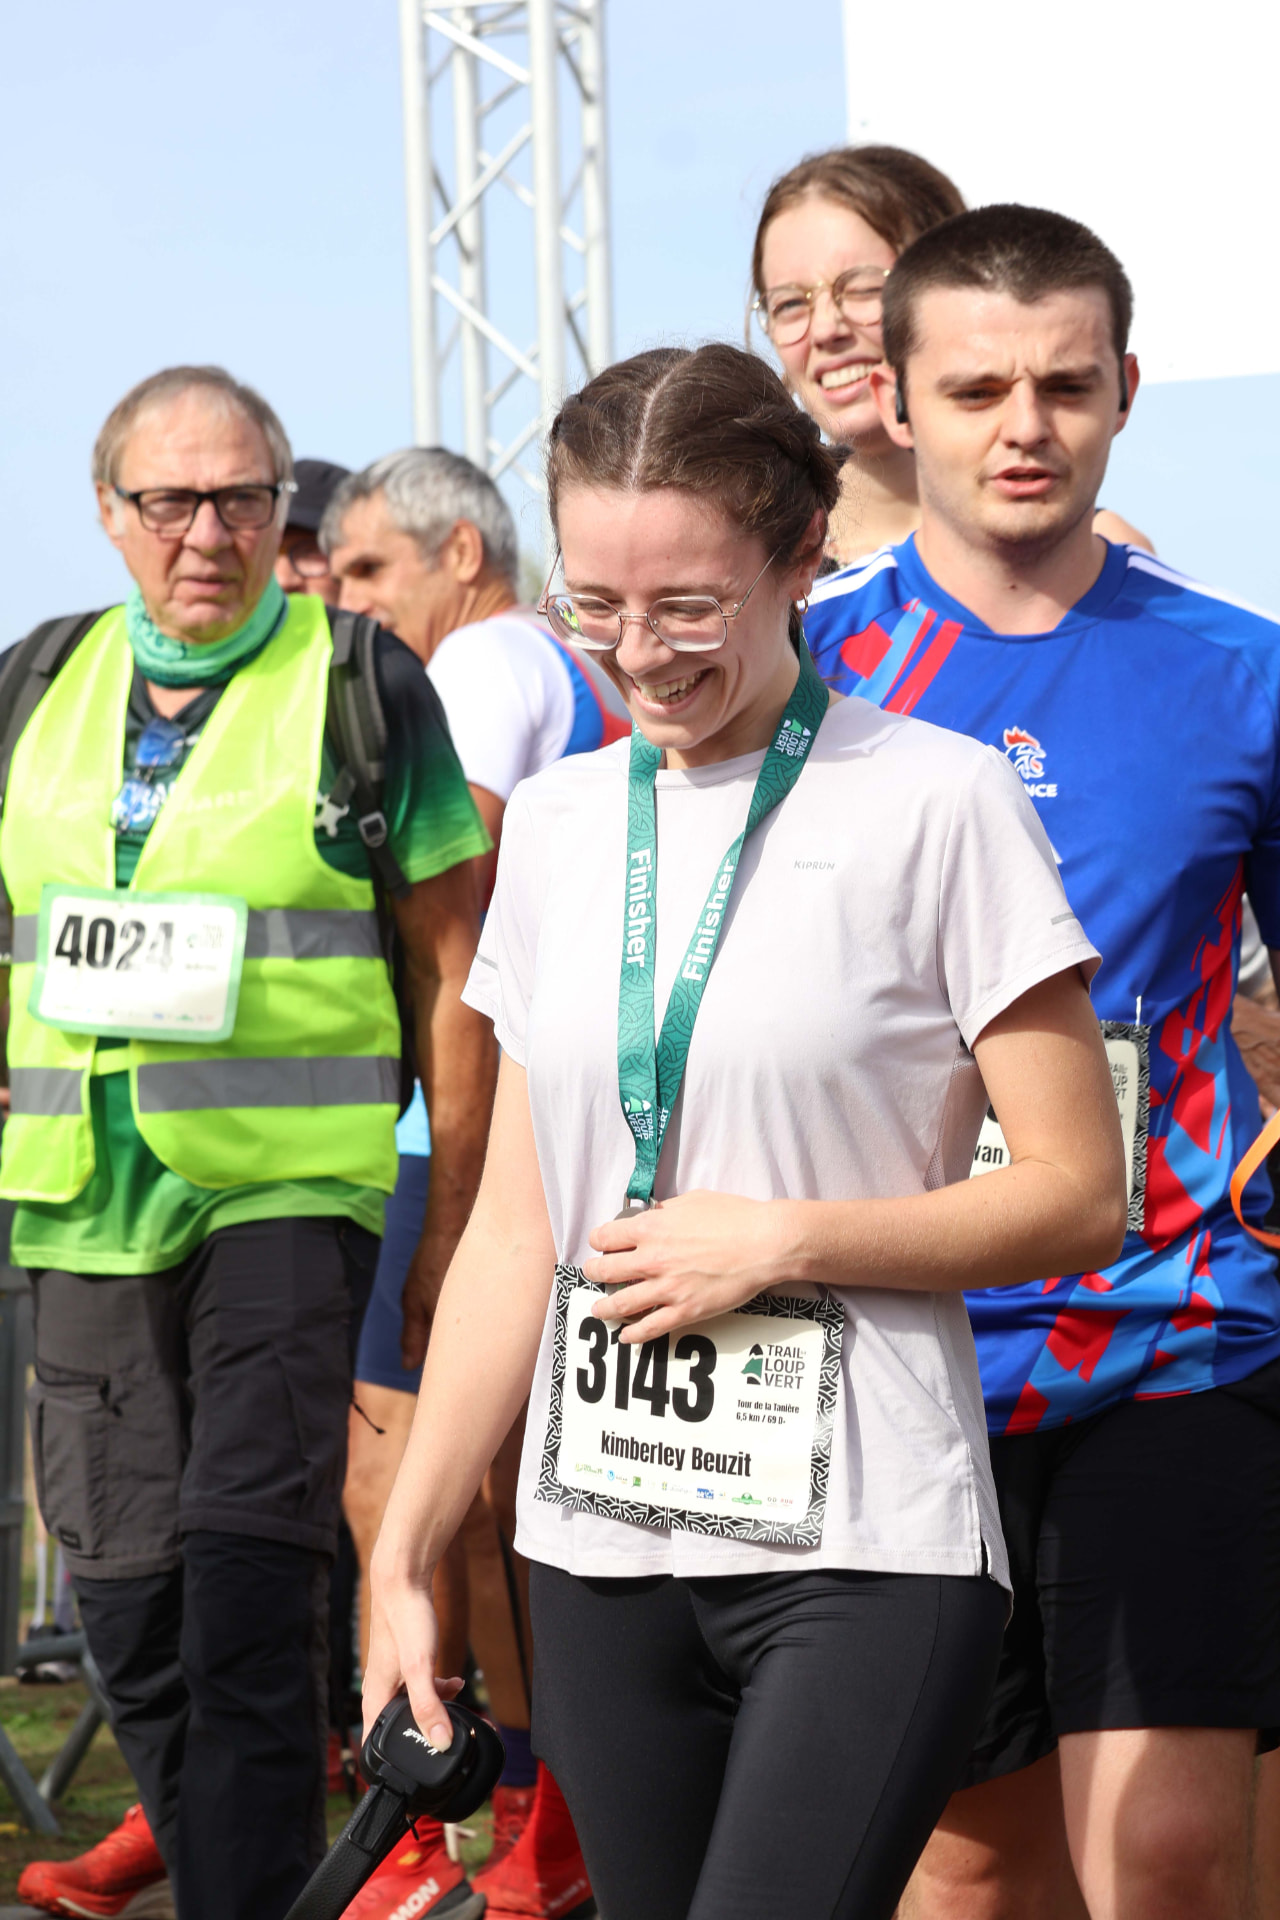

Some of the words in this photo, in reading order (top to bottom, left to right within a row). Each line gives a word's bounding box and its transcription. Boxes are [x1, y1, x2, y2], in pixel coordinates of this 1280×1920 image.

[774, 730, 791, 753] VERT
[785, 732, 801, 757] LOUP
[795, 737, 809, 757] TRAIL
[794, 860, 836, 870] KIPRUN
[626, 847, 653, 968] Finisher
[681, 858, 734, 981] Finisher
[55, 914, 174, 973] 4024
[628, 1113, 643, 1140] VERT
[635, 1112, 649, 1140] LOUP
[644, 1112, 654, 1140] TRAIL
[767, 1344, 803, 1359] TRAIL
[576, 1316, 717, 1423] 3143
[764, 1358, 806, 1374] LOUP
[764, 1373, 804, 1390] VERT
[736, 1411, 748, 1422] 6,5
[748, 1412, 760, 1422] km
[767, 1415, 777, 1424] 69
[737, 1399, 752, 1409] Tour
[754, 1401, 764, 1410] de
[765, 1402, 772, 1411] la
[601, 1430, 686, 1471] kimberley
[691, 1446, 752, 1478] Beuzit
